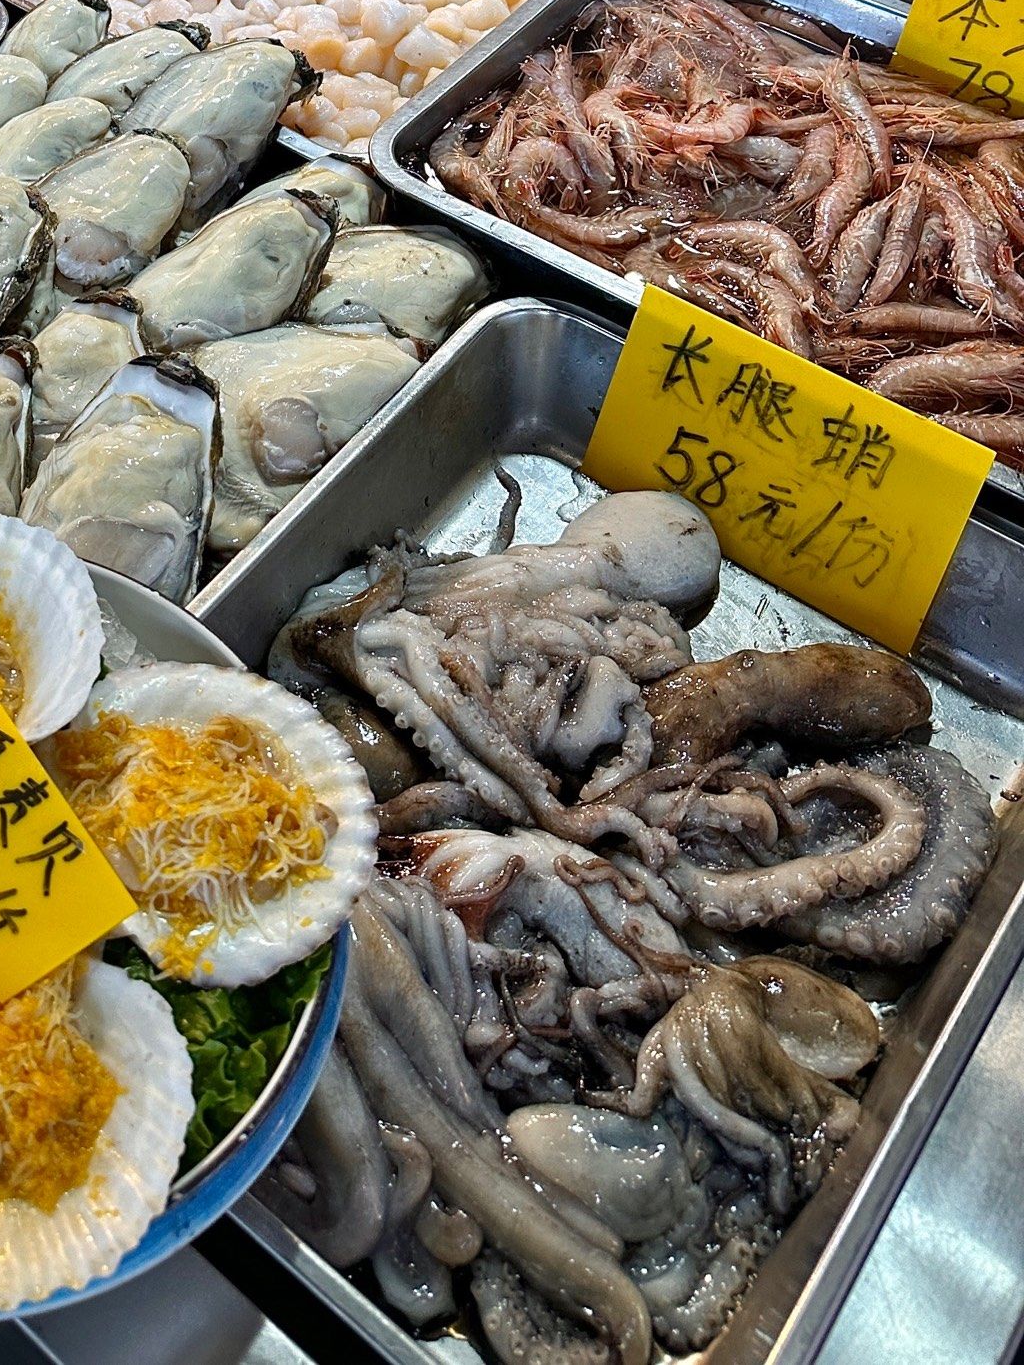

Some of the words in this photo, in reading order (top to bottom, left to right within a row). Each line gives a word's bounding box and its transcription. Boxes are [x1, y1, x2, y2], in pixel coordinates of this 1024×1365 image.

[661, 324, 897, 490] 长腿蛸
[653, 426, 901, 588] 58元/份
